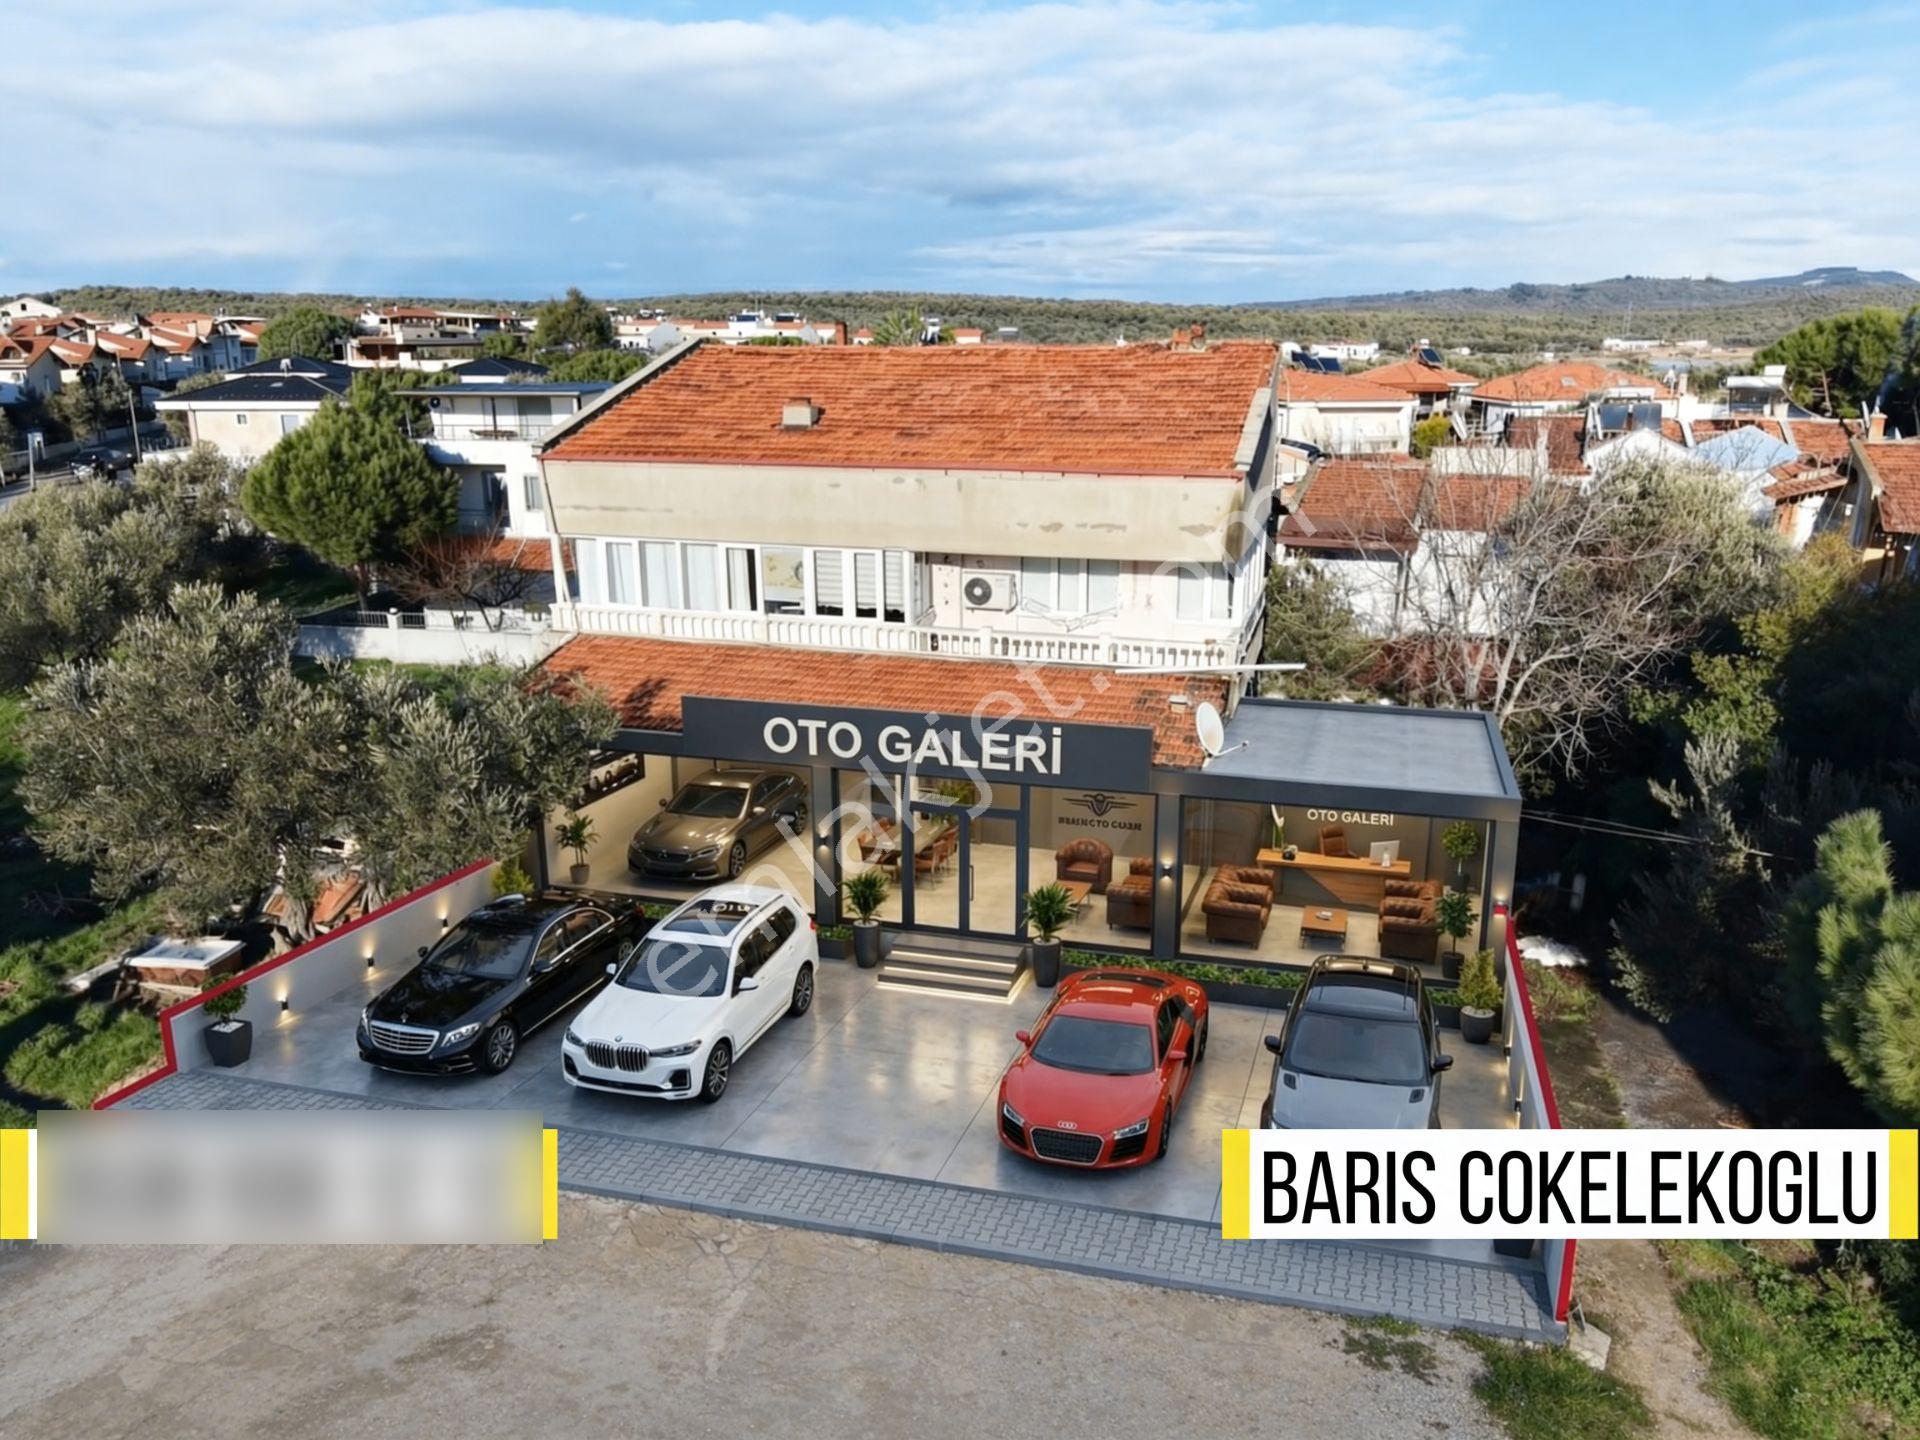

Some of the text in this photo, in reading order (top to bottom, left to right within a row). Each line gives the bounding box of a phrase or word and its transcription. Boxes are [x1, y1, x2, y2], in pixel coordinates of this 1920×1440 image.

[763, 717, 1061, 774] OTO GALERİ
[1307, 809, 1394, 826] OTO GALERI
